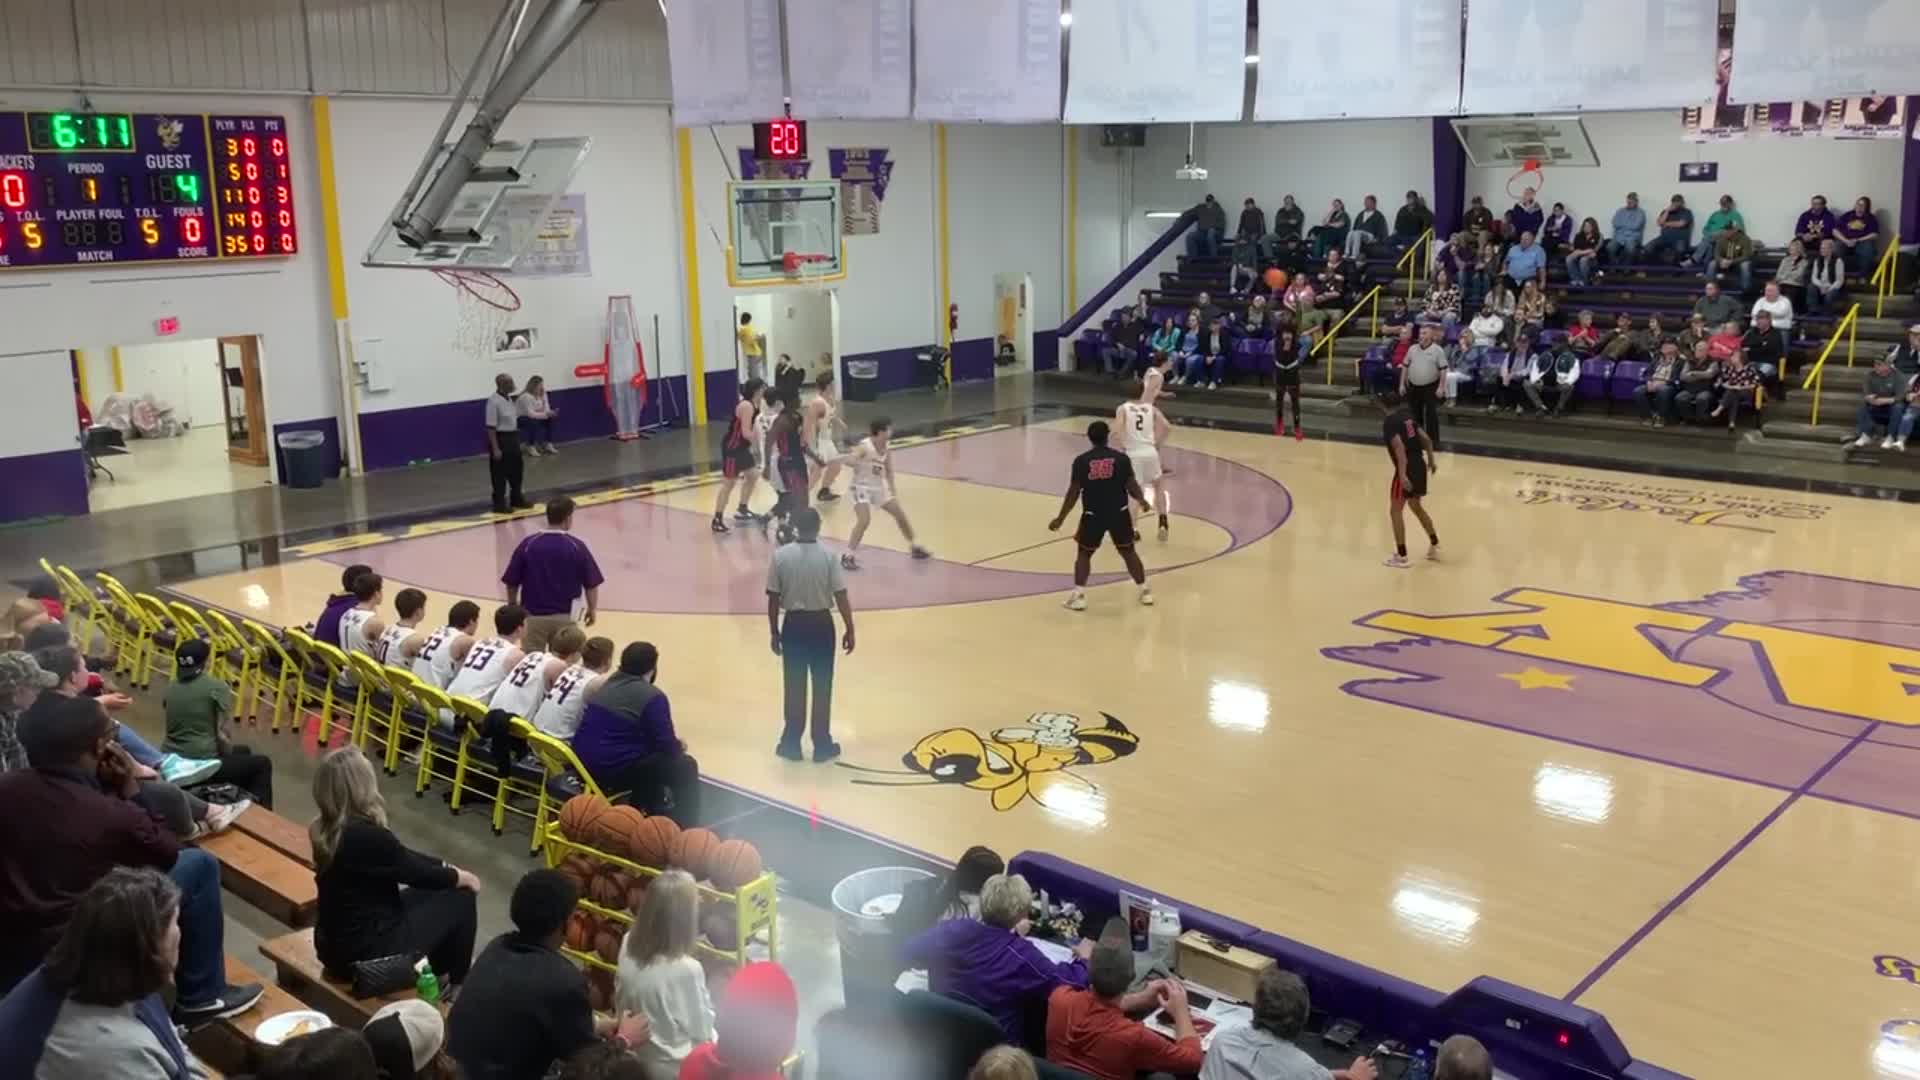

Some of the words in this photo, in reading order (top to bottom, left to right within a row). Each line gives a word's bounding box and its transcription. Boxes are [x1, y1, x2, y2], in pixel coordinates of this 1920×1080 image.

[53, 114, 129, 148] 6:11
[770, 124, 799, 154] 20
[226, 138, 238, 156] 3
[244, 138, 255, 156] 0
[272, 138, 284, 156] 0
[67, 163, 104, 174] PERIOD
[146, 154, 191, 169] GUEST
[229, 163, 240, 181] 5
[247, 163, 258, 181] 0
[280, 165, 286, 178] 1
[88, 179, 96, 201] 1
[177, 175, 197, 202] 4
[225, 189, 243, 203] 11
[249, 187, 260, 204] 0
[277, 186, 288, 204] 3
[56, 209, 95, 220] PLAYER
[99, 208, 124, 219] FOUL
[173, 207, 204, 217] FOULS
[227, 213, 246, 227] 14
[251, 211, 263, 228] 0
[279, 210, 290, 227] 0
[24, 223, 41, 249] 5
[143, 219, 158, 244] 5
[185, 218, 200, 242] 0
[178, 247, 208, 257] SCORE
[226, 235, 248, 252] 35
[253, 234, 264, 252] 0
[282, 234, 293, 251] 0
[78, 251, 113, 262] MATCH
[464, 647, 495, 671] 33
